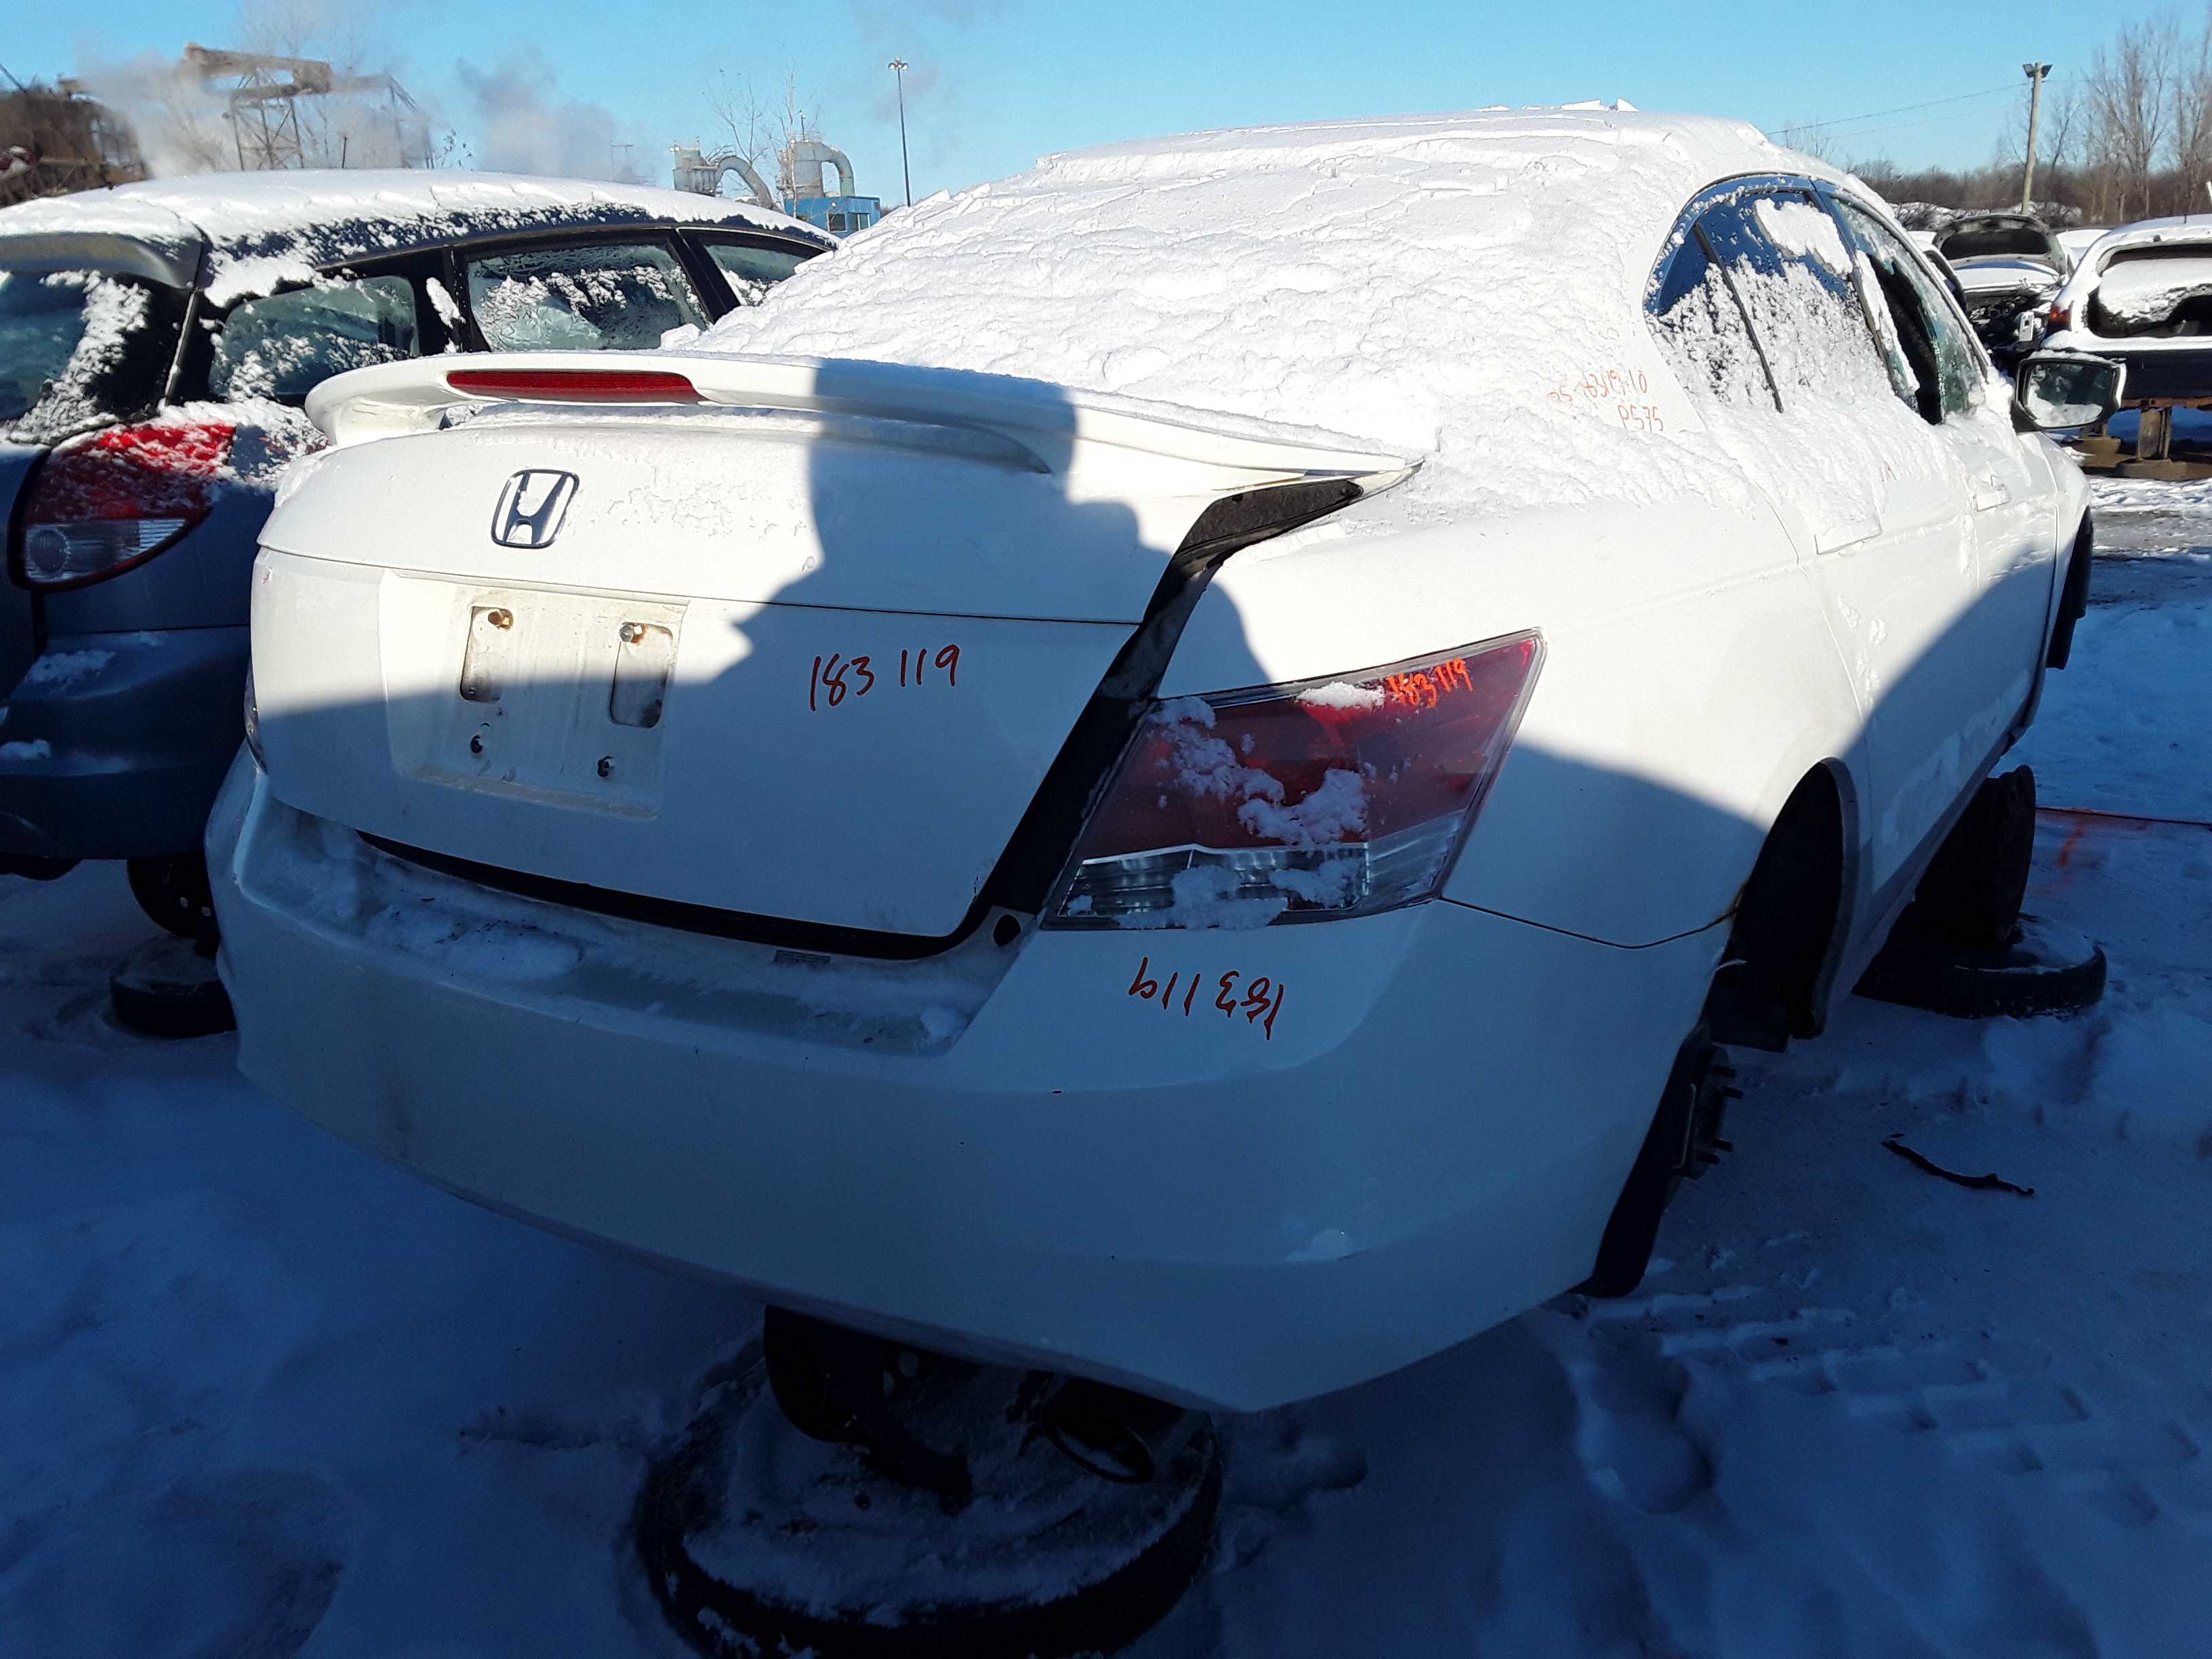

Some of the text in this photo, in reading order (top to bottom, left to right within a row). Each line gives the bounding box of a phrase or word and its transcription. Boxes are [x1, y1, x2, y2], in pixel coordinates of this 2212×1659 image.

[810, 644, 960, 712] 183 119
[1128, 956, 1284, 1040] 183 119
